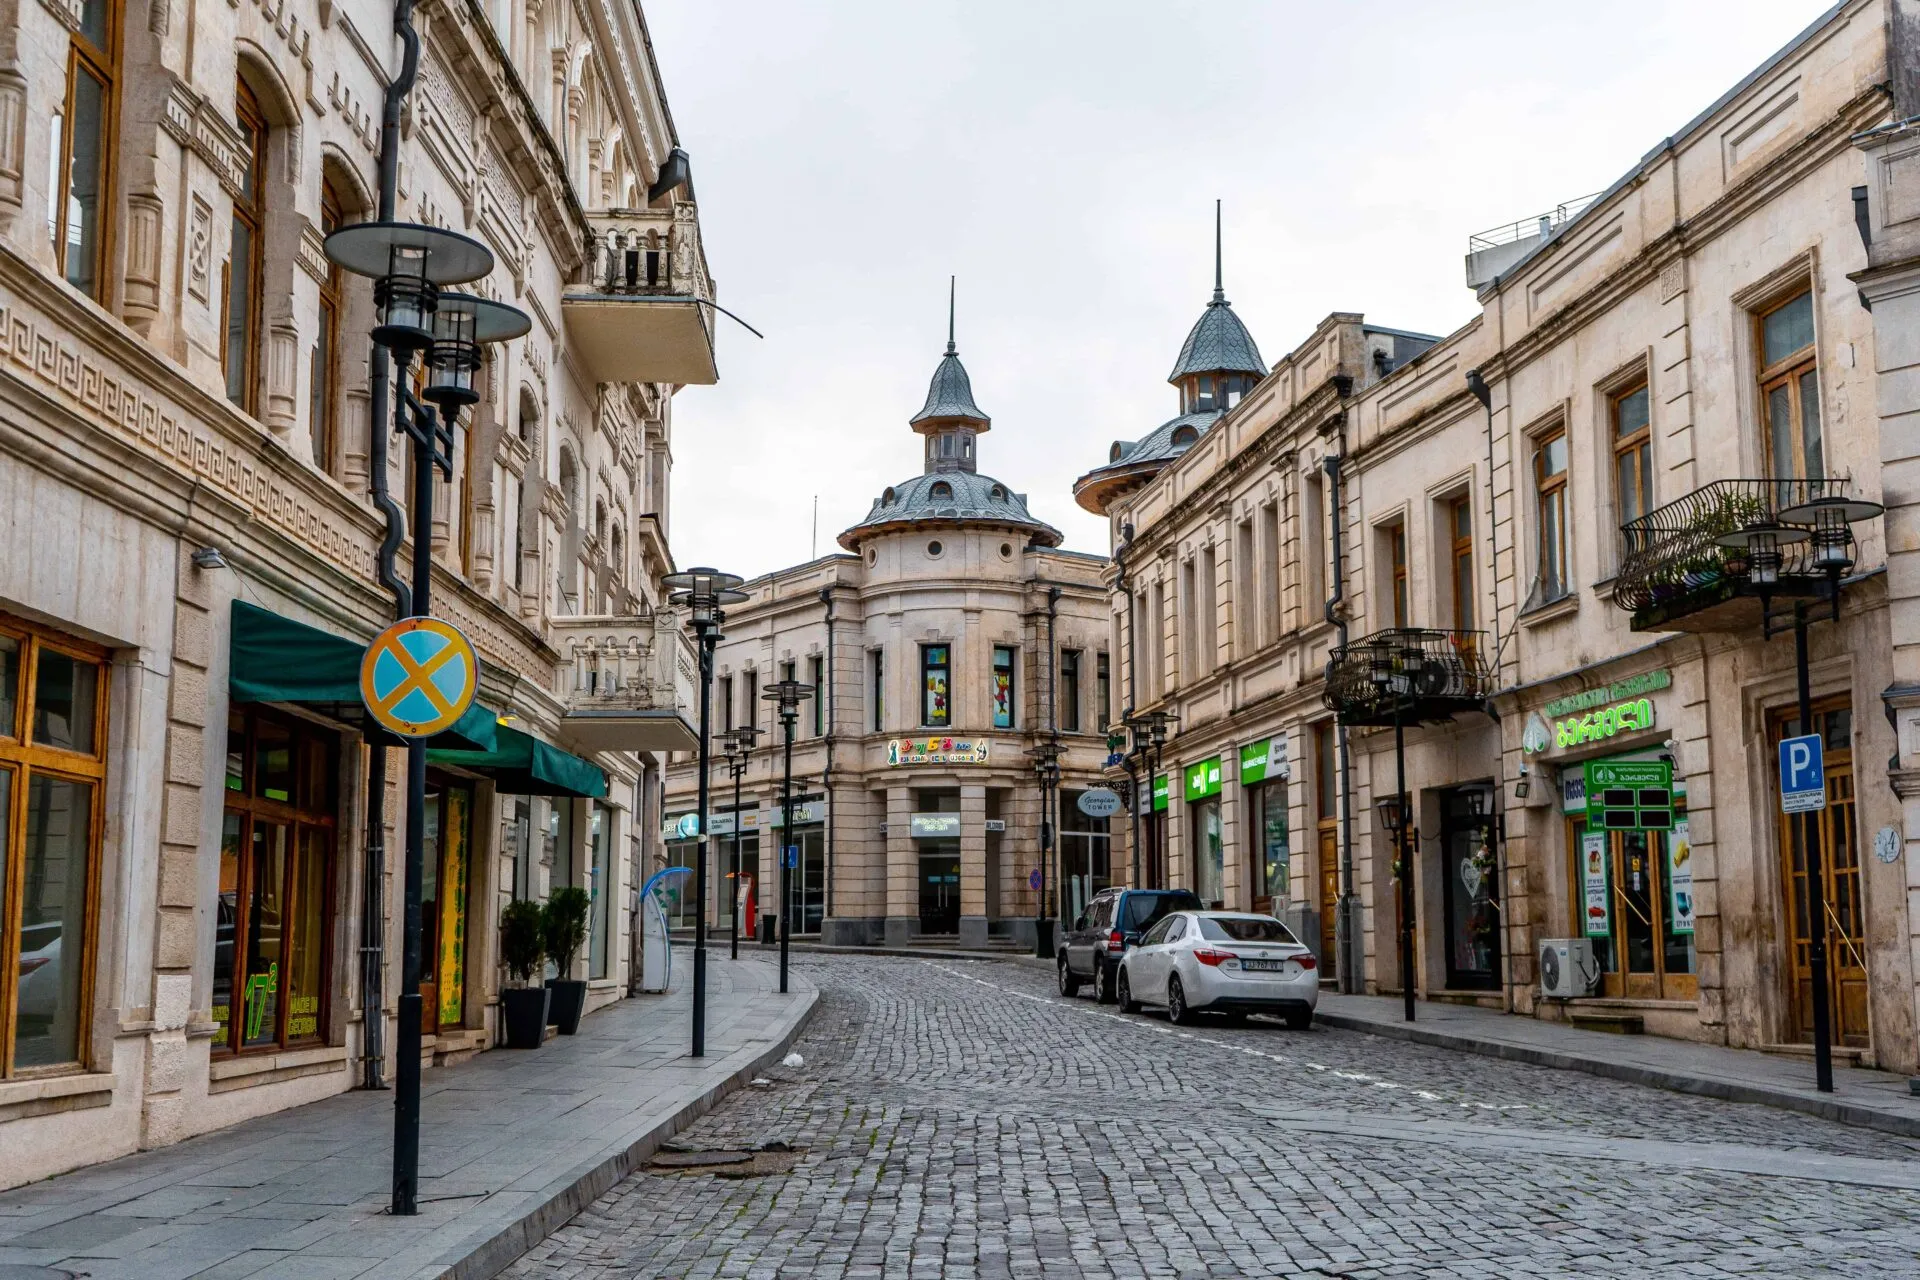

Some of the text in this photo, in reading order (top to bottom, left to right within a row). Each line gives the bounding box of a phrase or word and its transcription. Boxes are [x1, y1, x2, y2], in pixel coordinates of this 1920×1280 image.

[1556, 698, 1652, 748] ბერმელი
[1790, 742, 1811, 788] P
[1084, 796, 1116, 806] Georgian
[1888, 831, 1895, 850] 4
